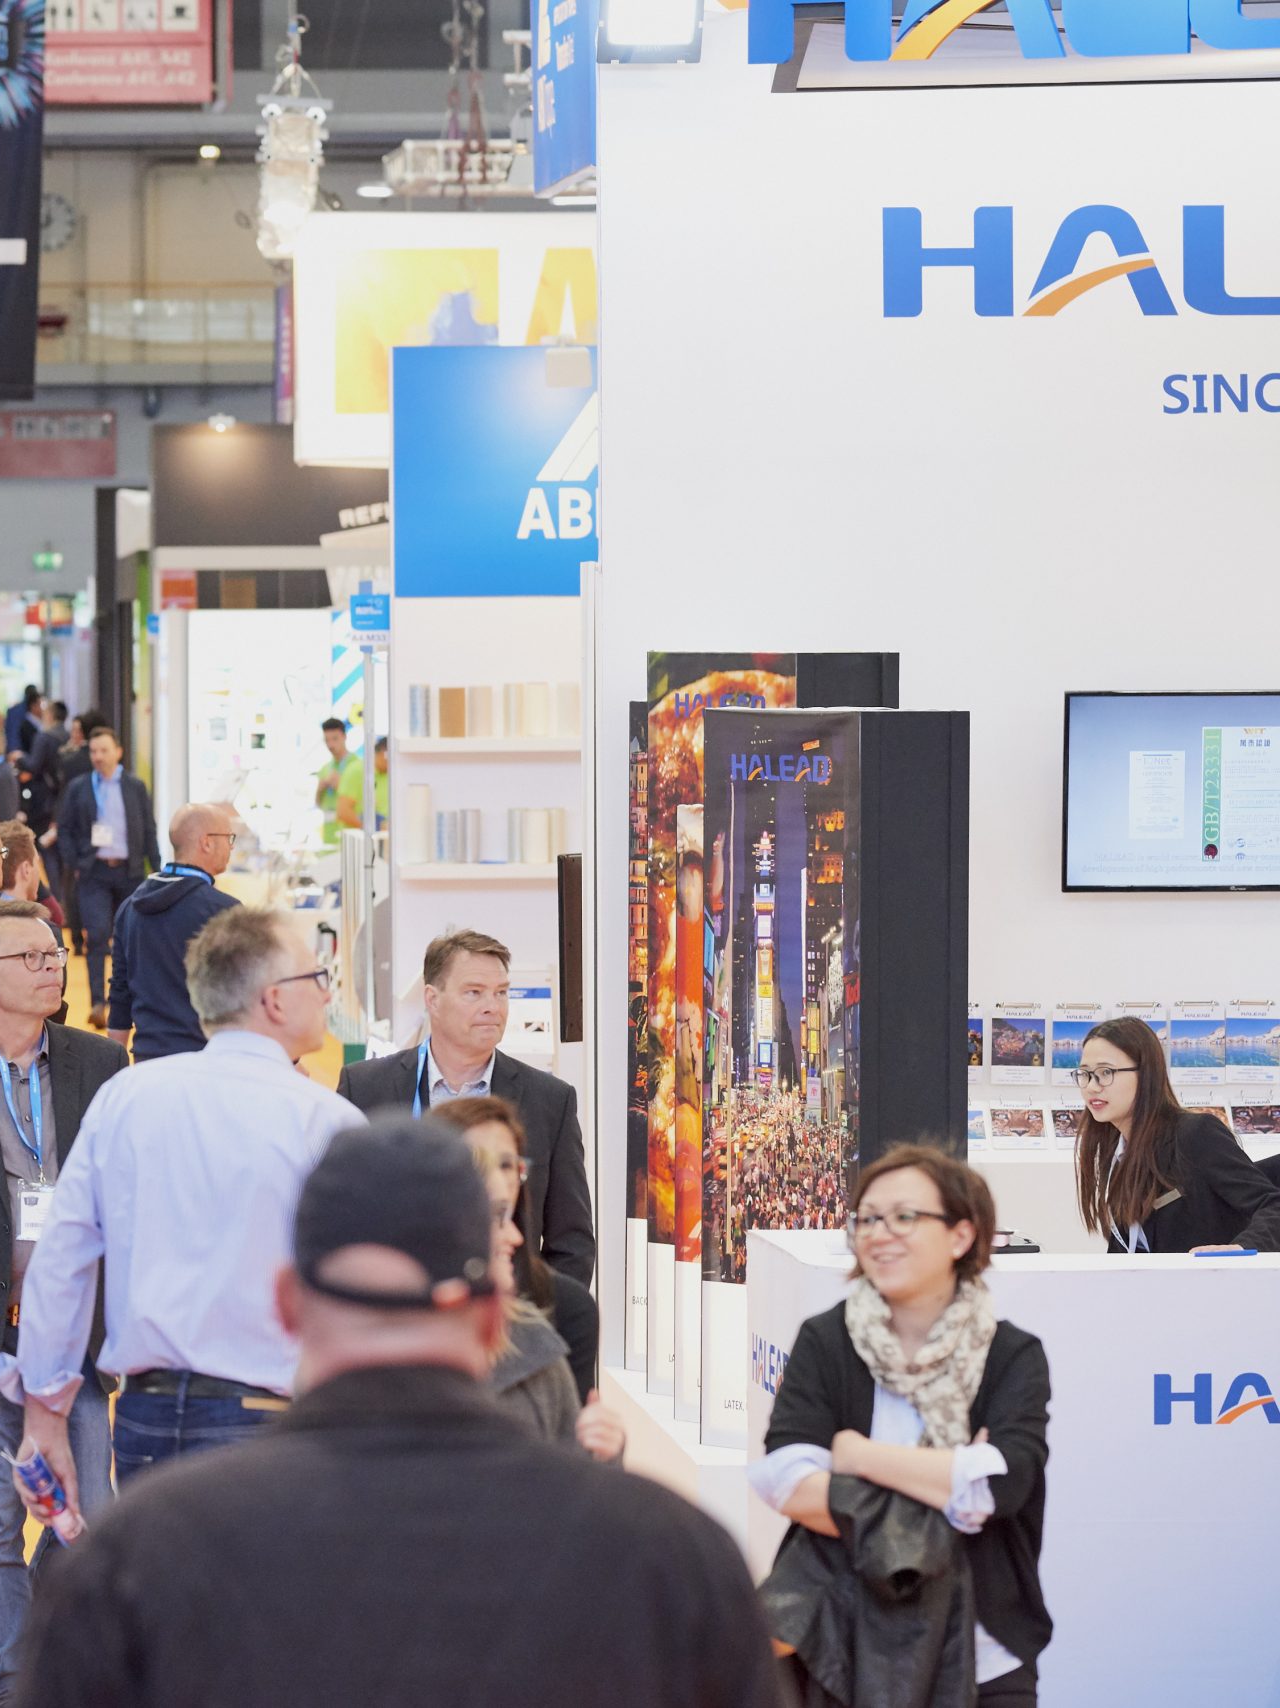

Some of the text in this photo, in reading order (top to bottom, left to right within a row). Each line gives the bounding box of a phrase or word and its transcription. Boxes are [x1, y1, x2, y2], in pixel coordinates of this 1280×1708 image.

[882, 204, 1280, 318] HAL
[1163, 372, 1280, 414] SINC
[338, 501, 389, 529] REF
[516, 487, 599, 539] AB
[730, 753, 829, 782] HALEAD
[752, 1332, 791, 1396] HALEA
[1153, 1372, 1280, 1424] HA
